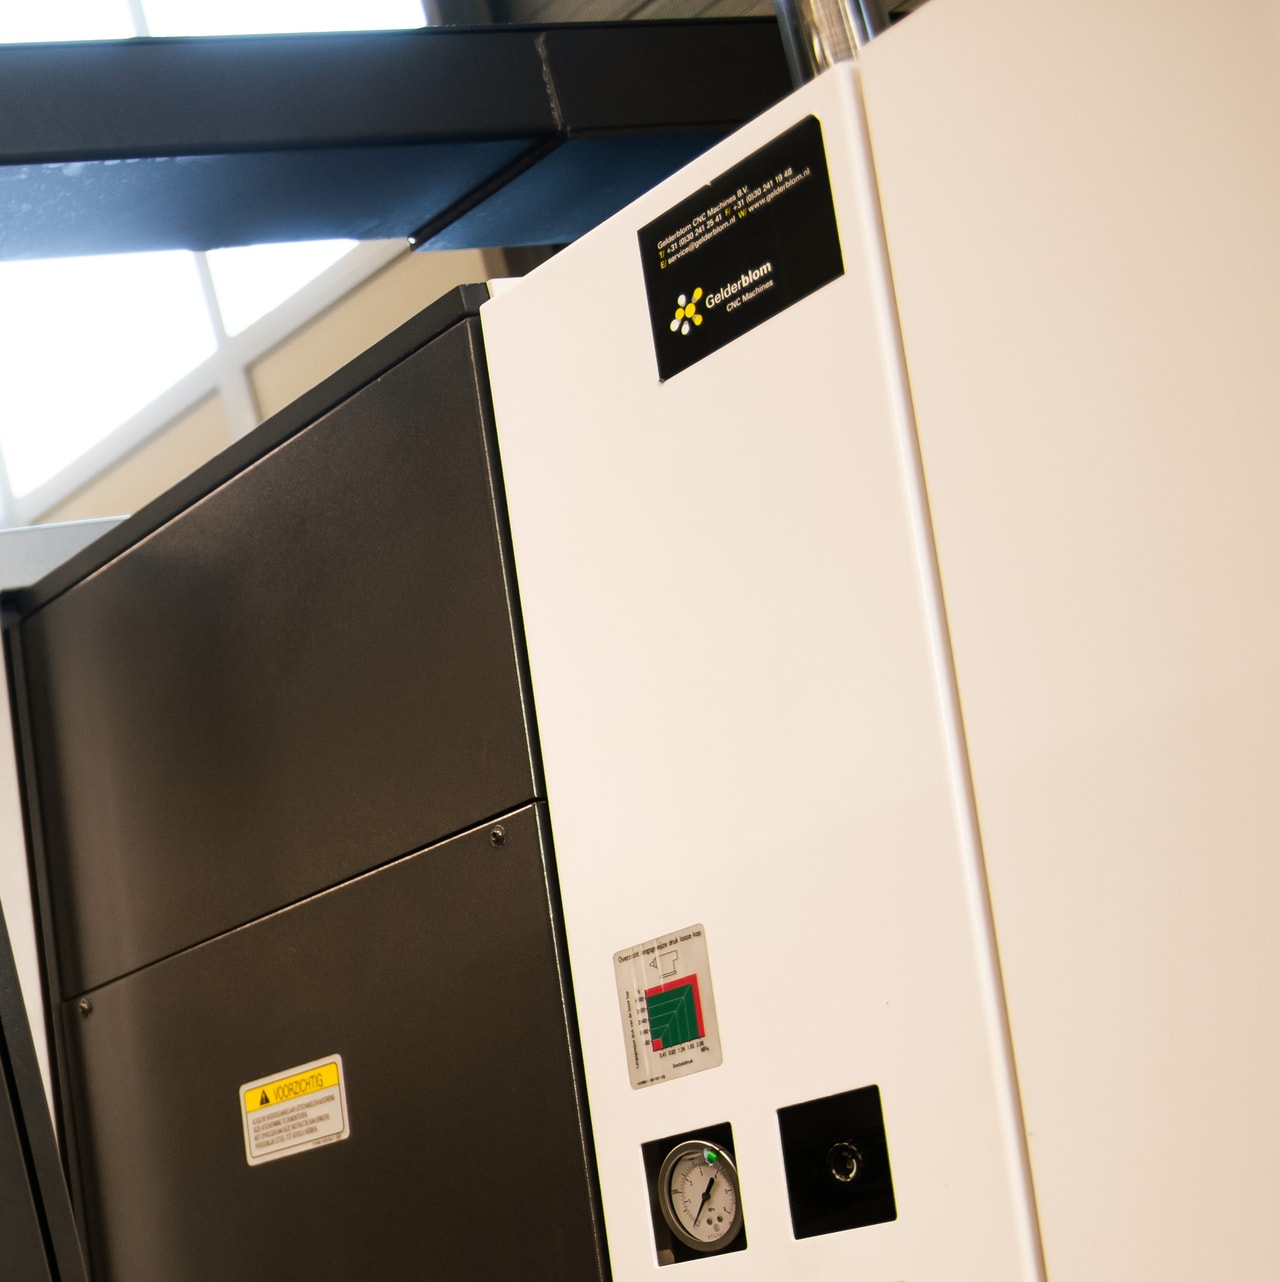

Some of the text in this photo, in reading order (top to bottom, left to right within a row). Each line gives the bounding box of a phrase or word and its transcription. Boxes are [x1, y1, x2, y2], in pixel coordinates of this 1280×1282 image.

[657, 224, 692, 249] Gelderblom
[692, 213, 706, 226] CNC
[707, 195, 736, 217] Machines
[667, 242, 678, 254] +31
[695, 225, 705, 236] 241
[715, 213, 722, 222] 41
[733, 199, 744, 211] +31
[762, 180, 773, 192] 241
[668, 215, 736, 264] service@gelderblom.nl
[748, 167, 810, 213] www.gelderblom.nl
[705, 262, 772, 309] Gelderblom
[726, 280, 773, 312] CNC Machines
[273, 1073, 324, 1101] VOORZICHTIG
